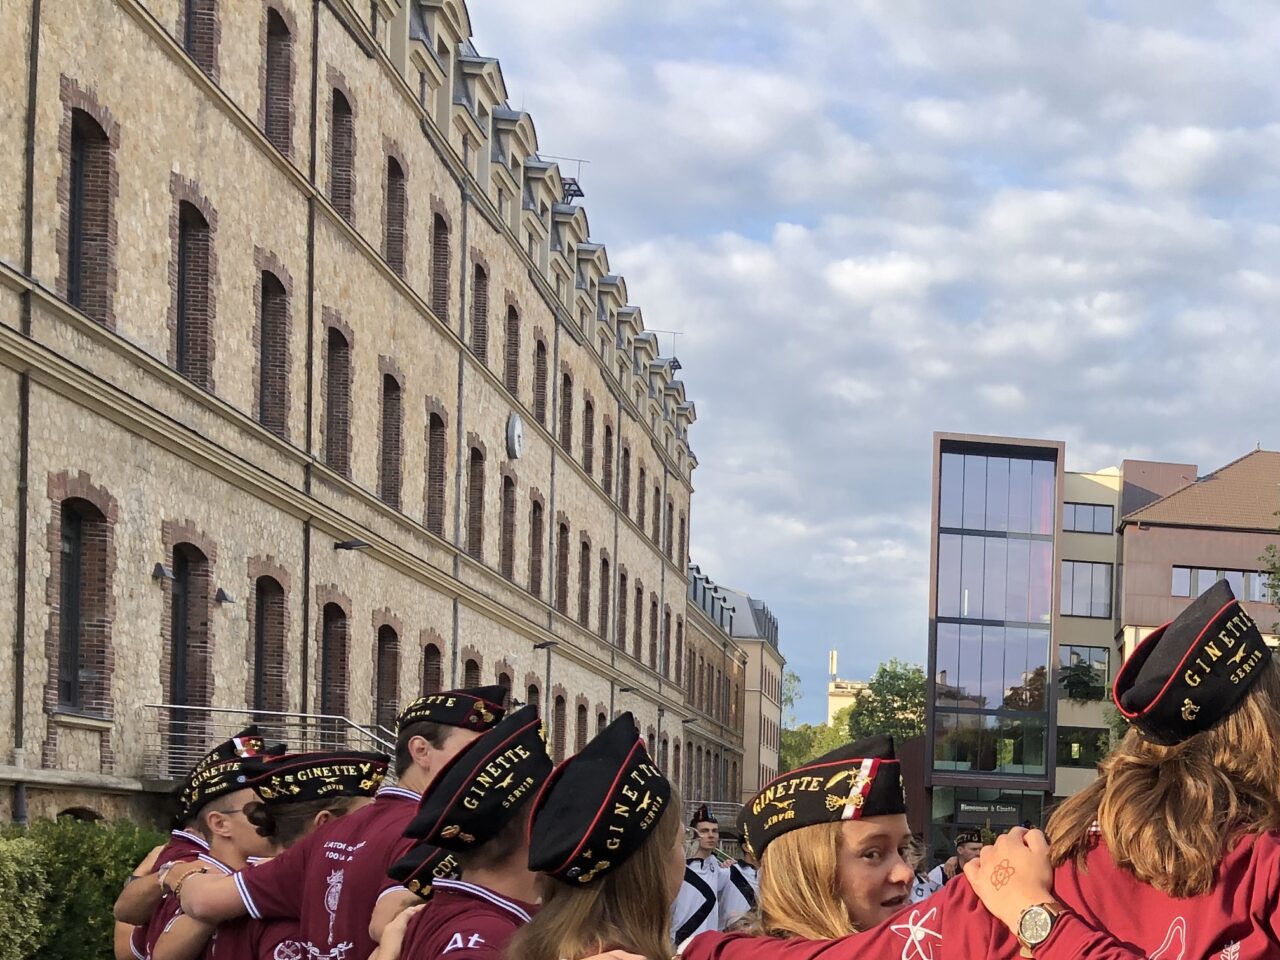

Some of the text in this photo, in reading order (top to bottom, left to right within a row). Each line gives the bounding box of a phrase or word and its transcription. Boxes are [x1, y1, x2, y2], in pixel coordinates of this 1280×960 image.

[191, 762, 242, 788] GINETTE
[297, 764, 358, 781] GINETTE
[463, 744, 531, 810] GINETTE
[317, 783, 344, 795] SERVIR
[752, 776, 824, 816] GINETTE
[763, 810, 795, 831] SERVIR
[432, 854, 458, 878] CDT
[442, 932, 486, 954] At
